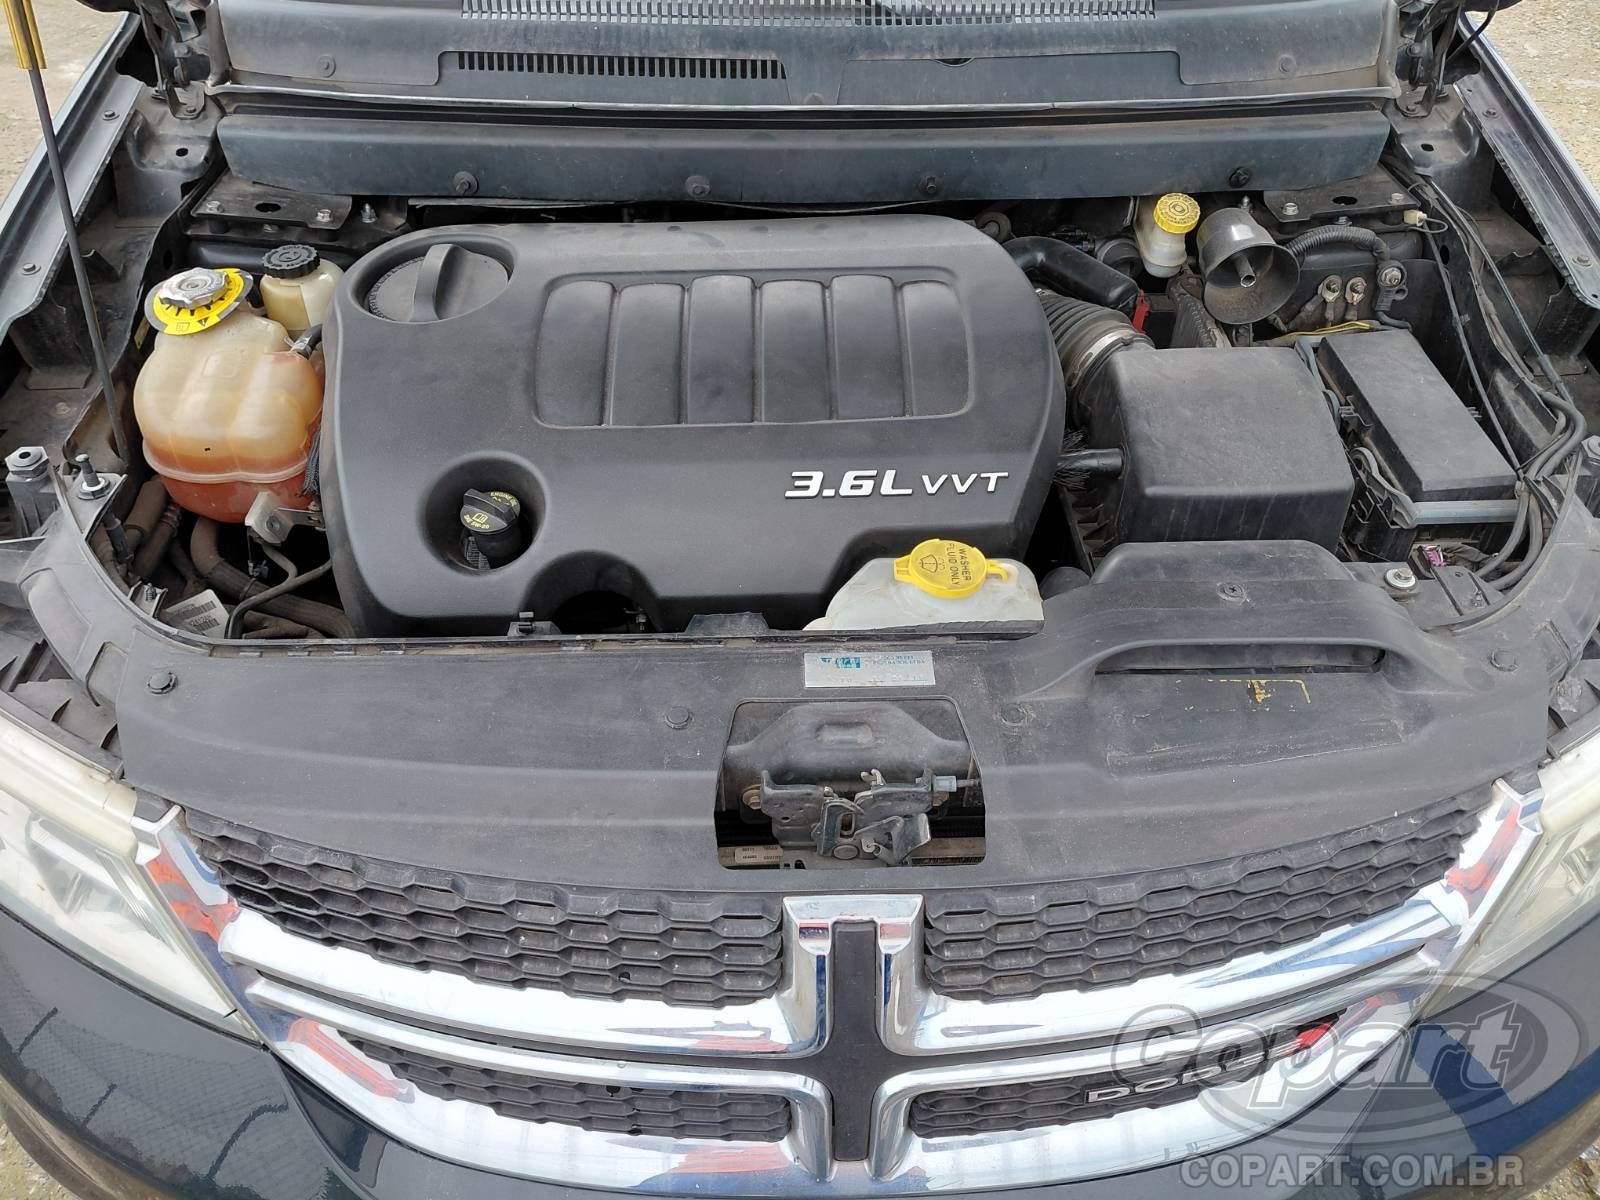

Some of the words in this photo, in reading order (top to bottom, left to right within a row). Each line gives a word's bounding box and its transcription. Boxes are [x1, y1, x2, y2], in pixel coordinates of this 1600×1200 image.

[784, 469, 913, 499] 3.6L
[921, 471, 1010, 495] VVT
[946, 543, 958, 565] FLUID
[958, 547, 972, 581] WASHER
[949, 566, 961, 586] ONLY
